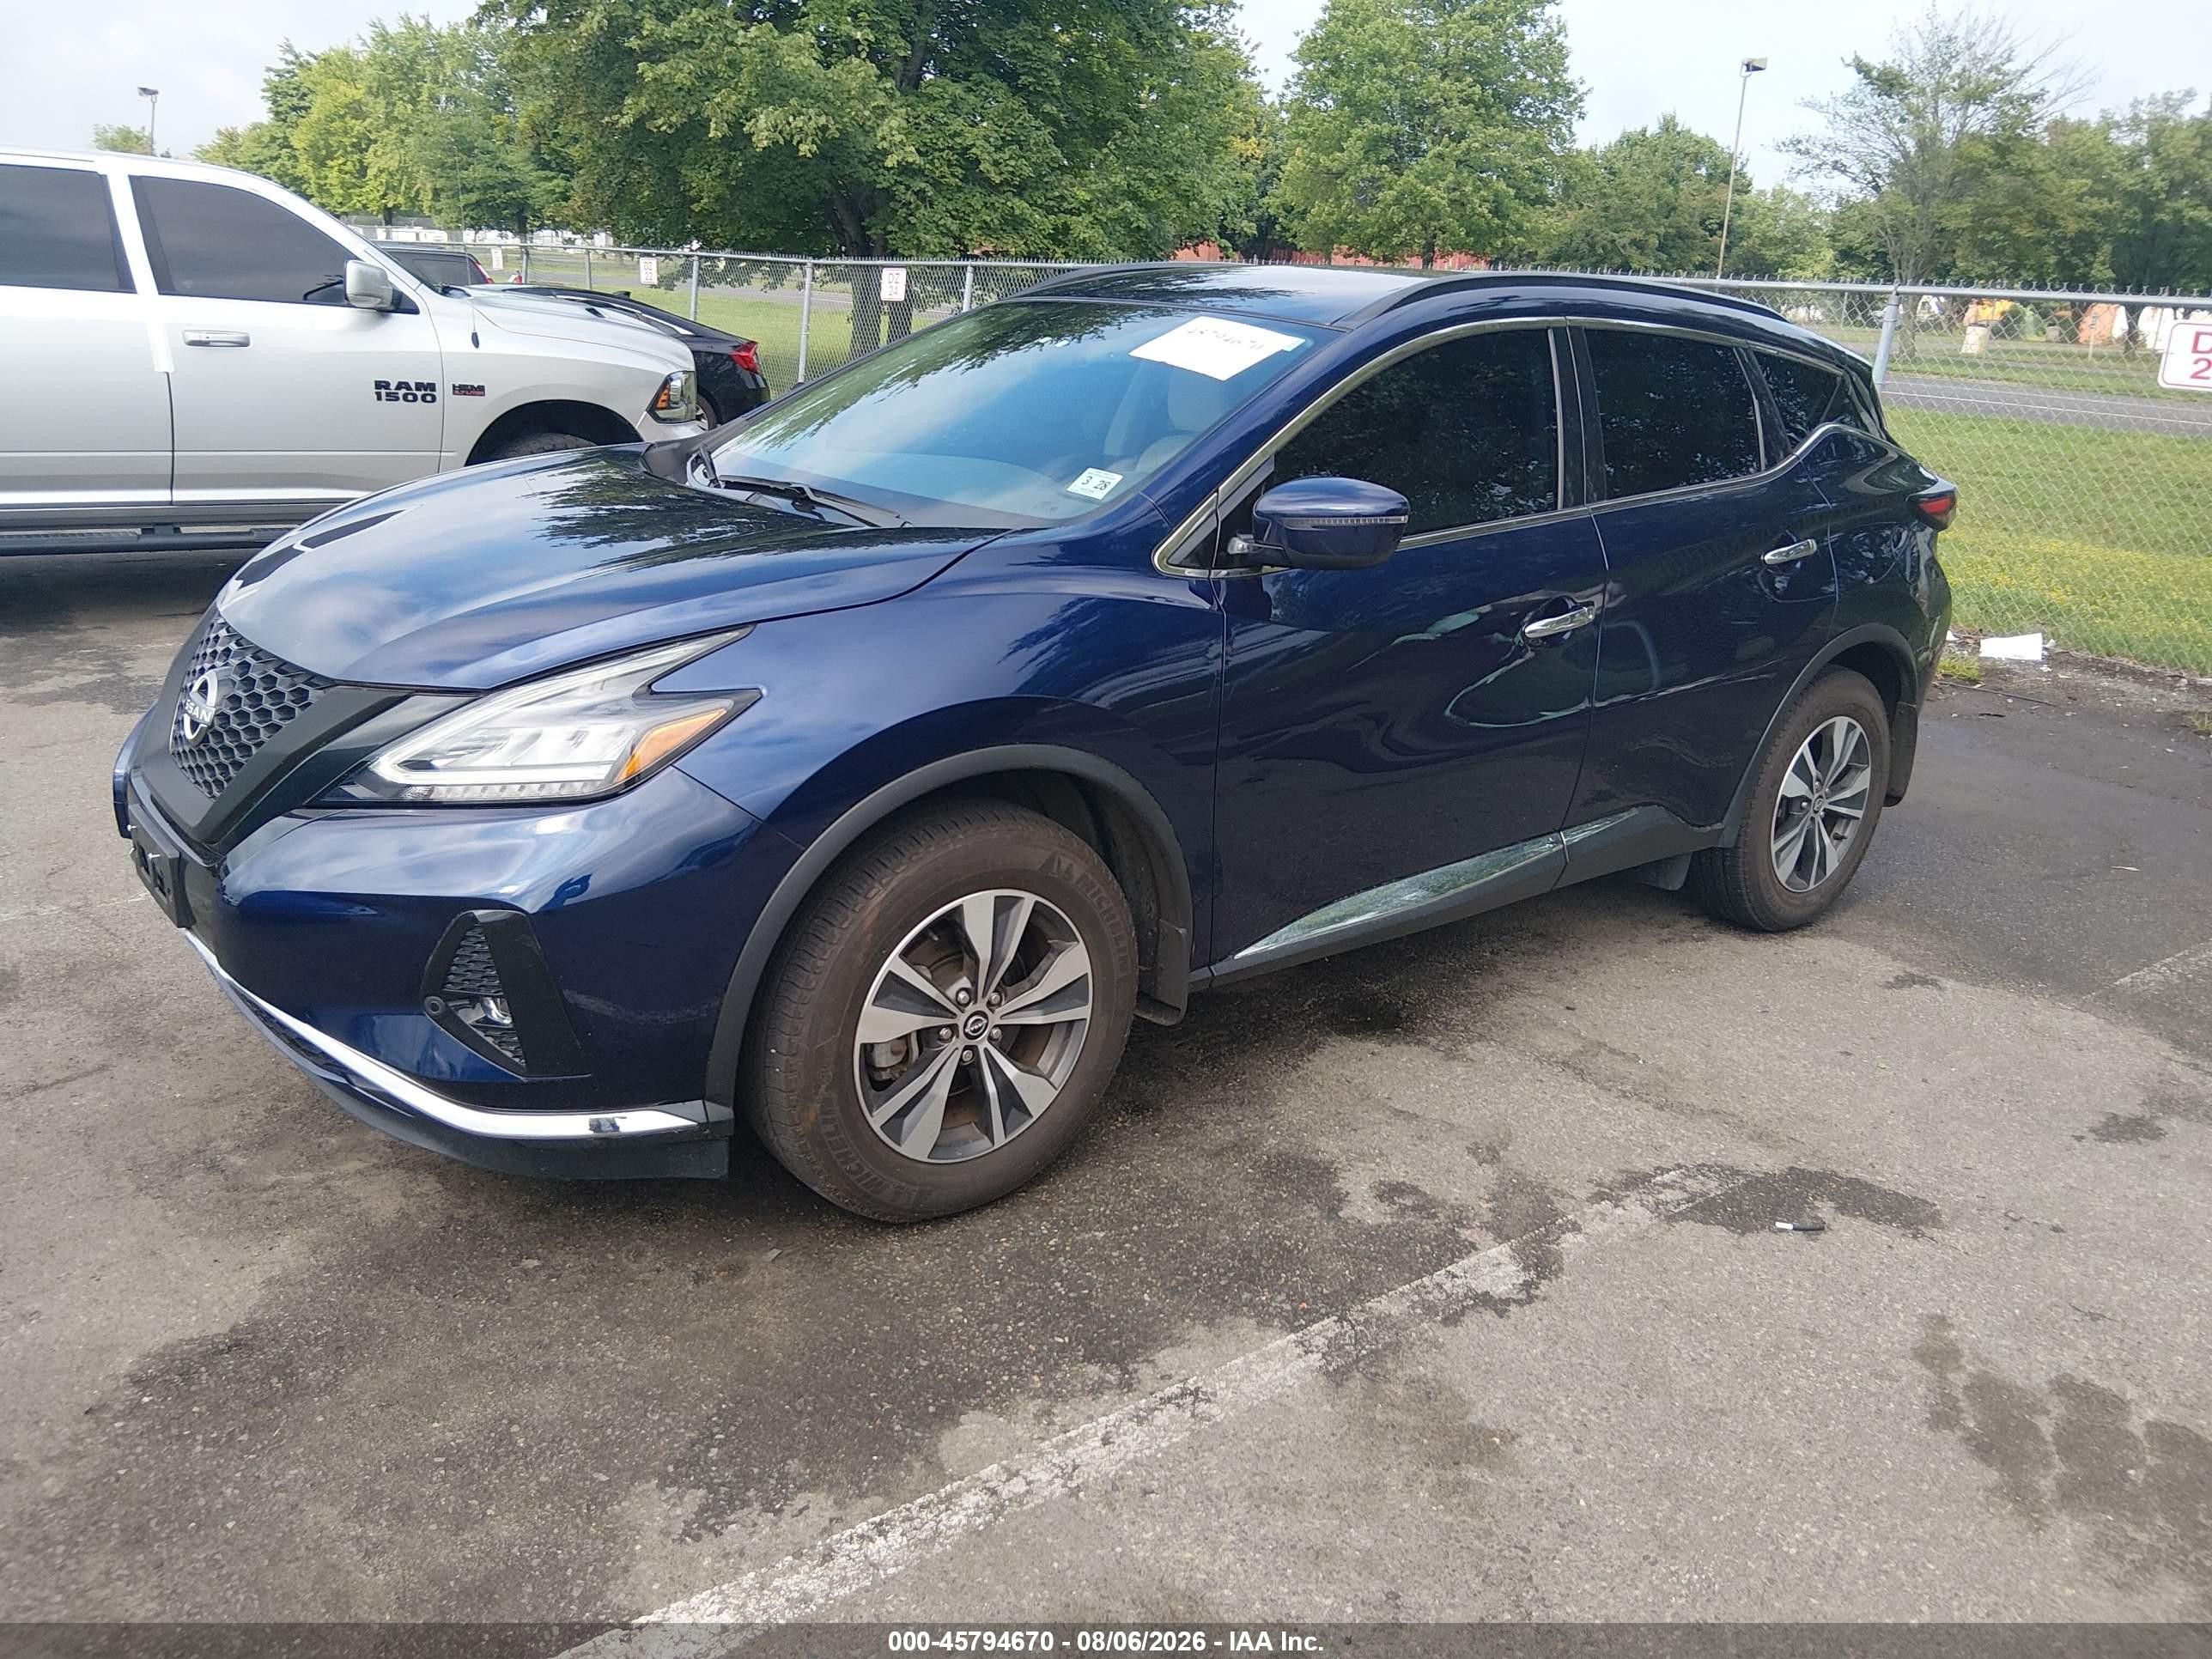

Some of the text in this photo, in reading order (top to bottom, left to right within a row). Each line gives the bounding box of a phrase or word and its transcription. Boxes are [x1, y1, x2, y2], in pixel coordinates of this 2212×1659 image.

[888, 273, 900, 284] DZ
[888, 285, 898, 295] 24
[374, 380, 436, 392] RAM
[374, 392, 437, 404] 1500
[1081, 476, 1093, 485] 3
[1093, 480, 1111, 491] 28
